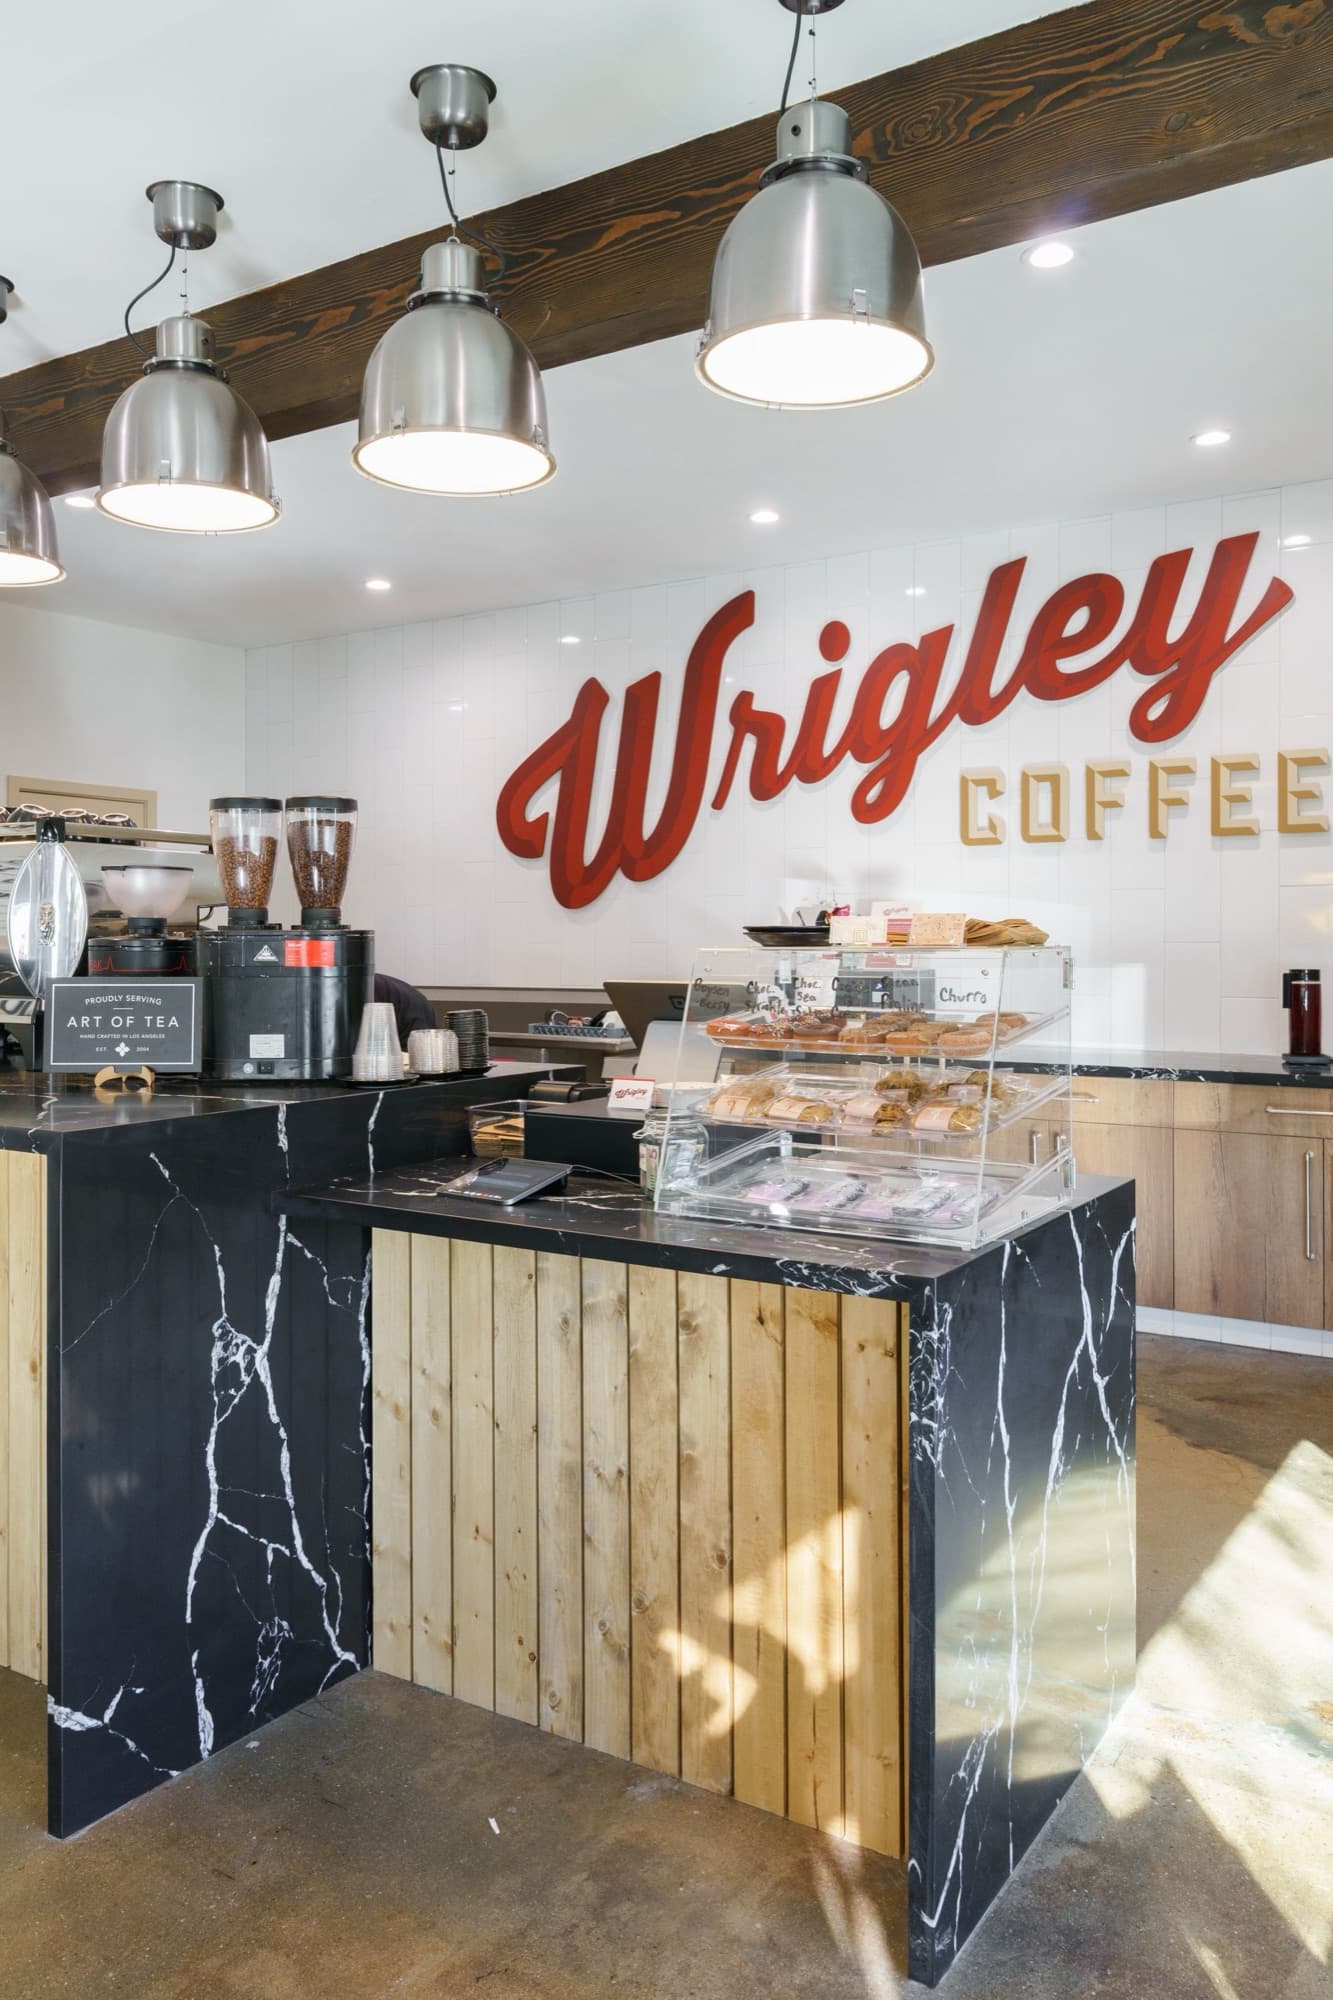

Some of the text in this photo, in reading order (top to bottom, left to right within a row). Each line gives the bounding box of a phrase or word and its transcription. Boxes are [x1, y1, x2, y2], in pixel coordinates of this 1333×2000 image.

[495, 530, 1294, 910] Wrigley
[960, 748, 1330, 846] COFFEE
[85, 994, 162, 1006] PROUDLY SERVING
[796, 991, 817, 1003] Sea
[940, 986, 988, 1004] Churro
[66, 1016, 179, 1028] ART OF TEA
